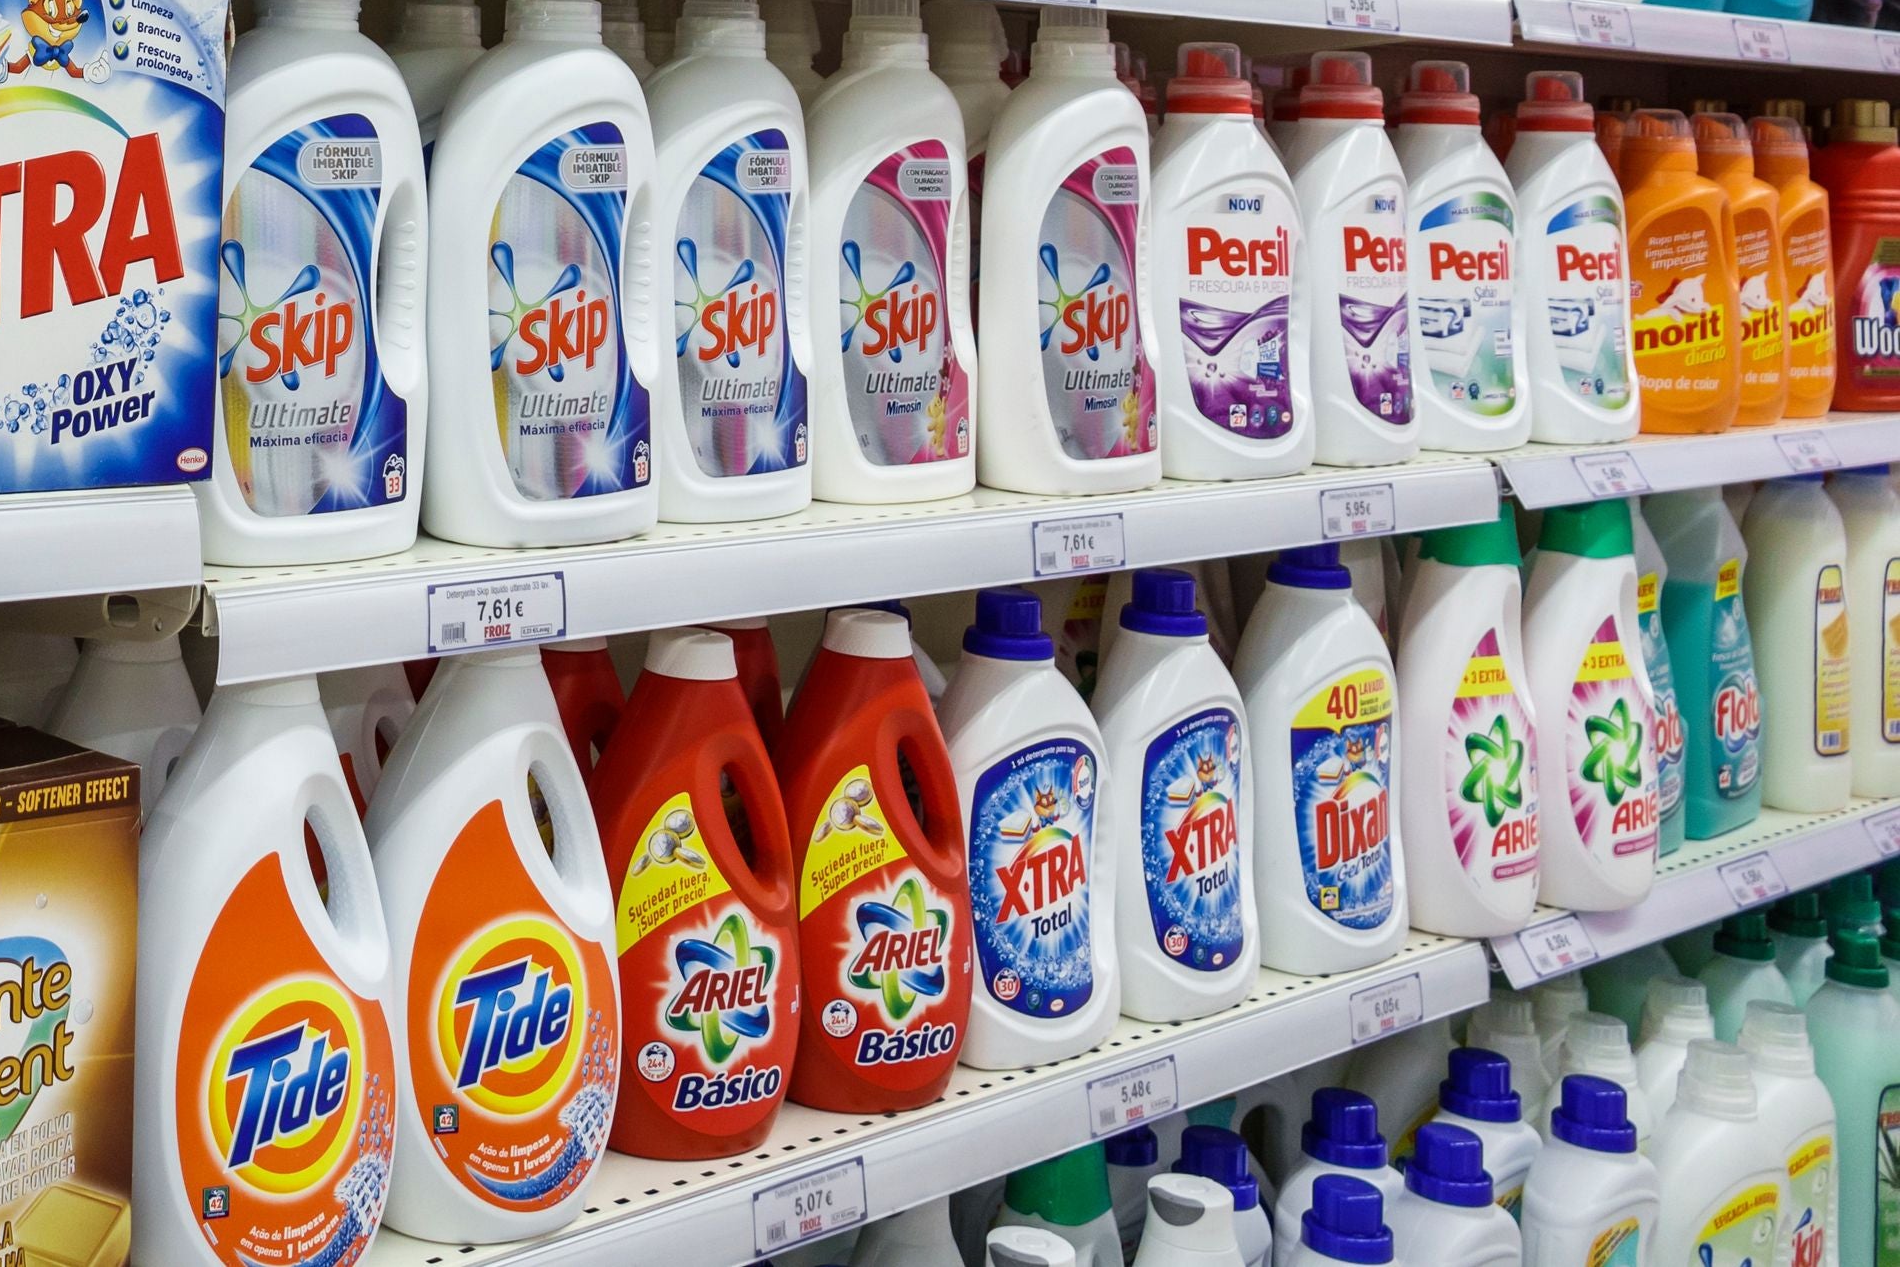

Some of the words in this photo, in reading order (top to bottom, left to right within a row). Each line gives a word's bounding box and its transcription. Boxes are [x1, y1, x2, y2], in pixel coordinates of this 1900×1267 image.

[137, 20, 182, 44] Brancura
[138, 41, 182, 64] Frescura
[312, 158, 374, 170] IMBATIBLE
[331, 168, 359, 180] SKIP
[1229, 196, 1261, 212] NOVO
[1189, 280, 1251, 293] FRESCURA
[1633, 312, 1721, 350] norit
[1685, 345, 1726, 367] diario
[72, 358, 138, 405] OXY
[865, 367, 937, 395] Ultimate
[1064, 367, 1131, 392] Ultimate
[50, 386, 156, 445] Power
[248, 400, 352, 429] Ultimate
[519, 391, 608, 420] Ultimate
[249, 435, 300, 448] Máxima
[303, 431, 348, 446] eficacia
[1326, 685, 1358, 720] 40
[17, 783, 81, 814] SOFTENER
[86, 775, 130, 804] EFFECT
[1316, 788, 1389, 872] Dixan
[855, 925, 943, 974] ARIEL
[671, 965, 769, 1014] ARIEL
[453, 957, 571, 1093] Tide
[857, 1025, 955, 1064] Básico
[225, 1019, 351, 1170] Tide
[675, 1067, 781, 1110] Básico
